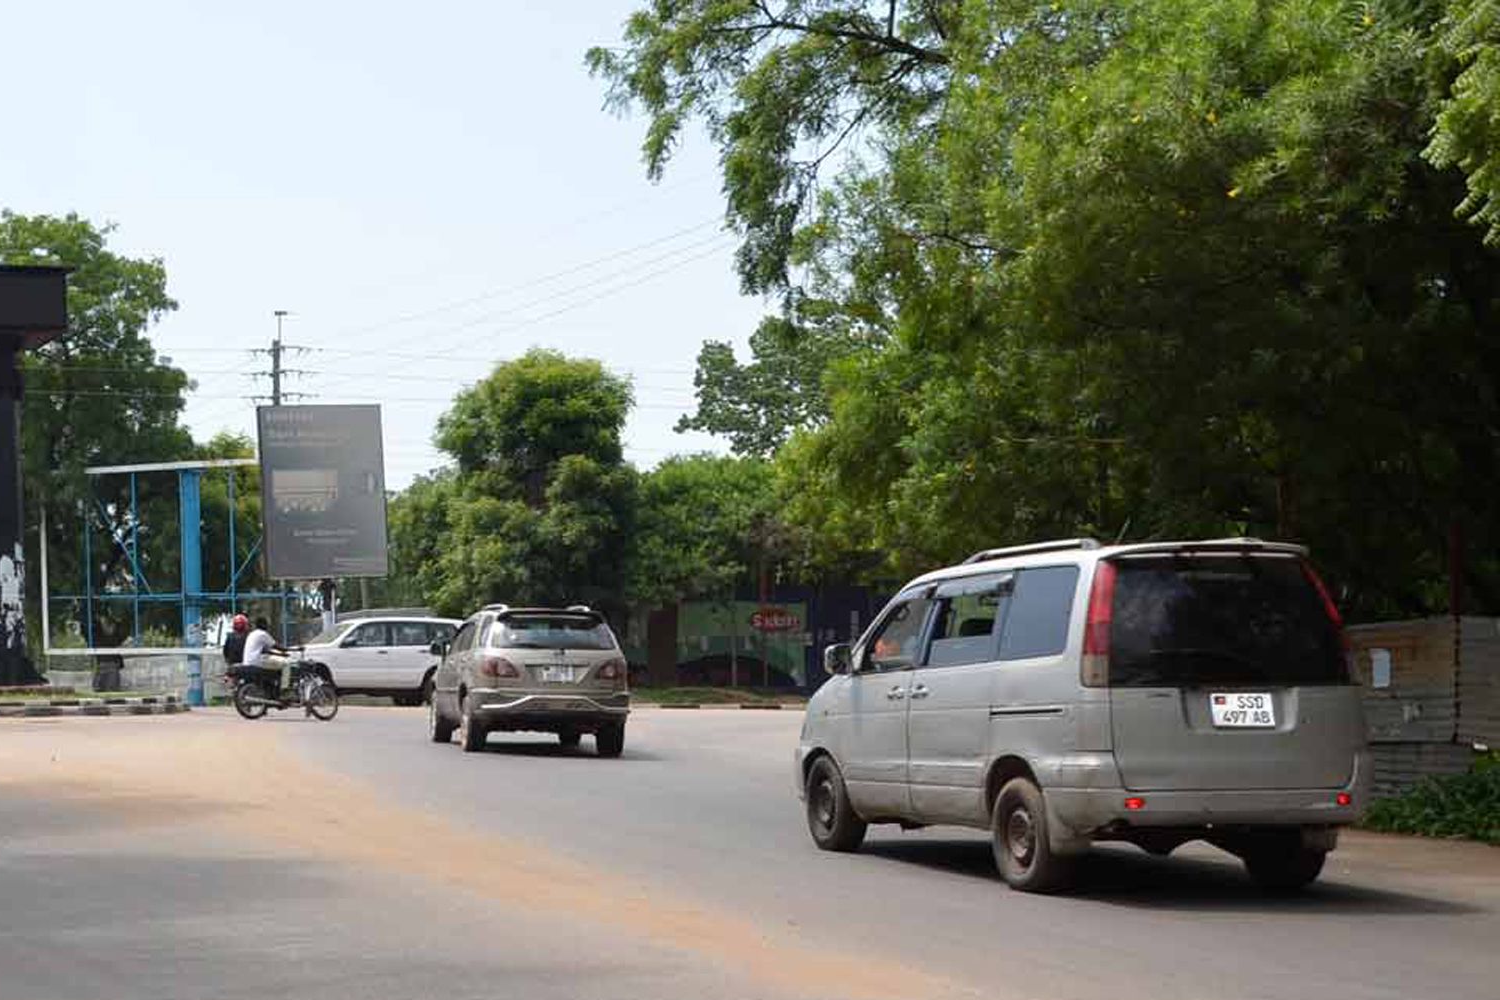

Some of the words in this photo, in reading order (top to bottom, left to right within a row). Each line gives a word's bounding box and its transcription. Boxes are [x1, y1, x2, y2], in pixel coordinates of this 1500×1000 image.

[1237, 695, 1264, 709] SSD
[1223, 710, 1247, 723] 497
[1253, 710, 1271, 723] AB
